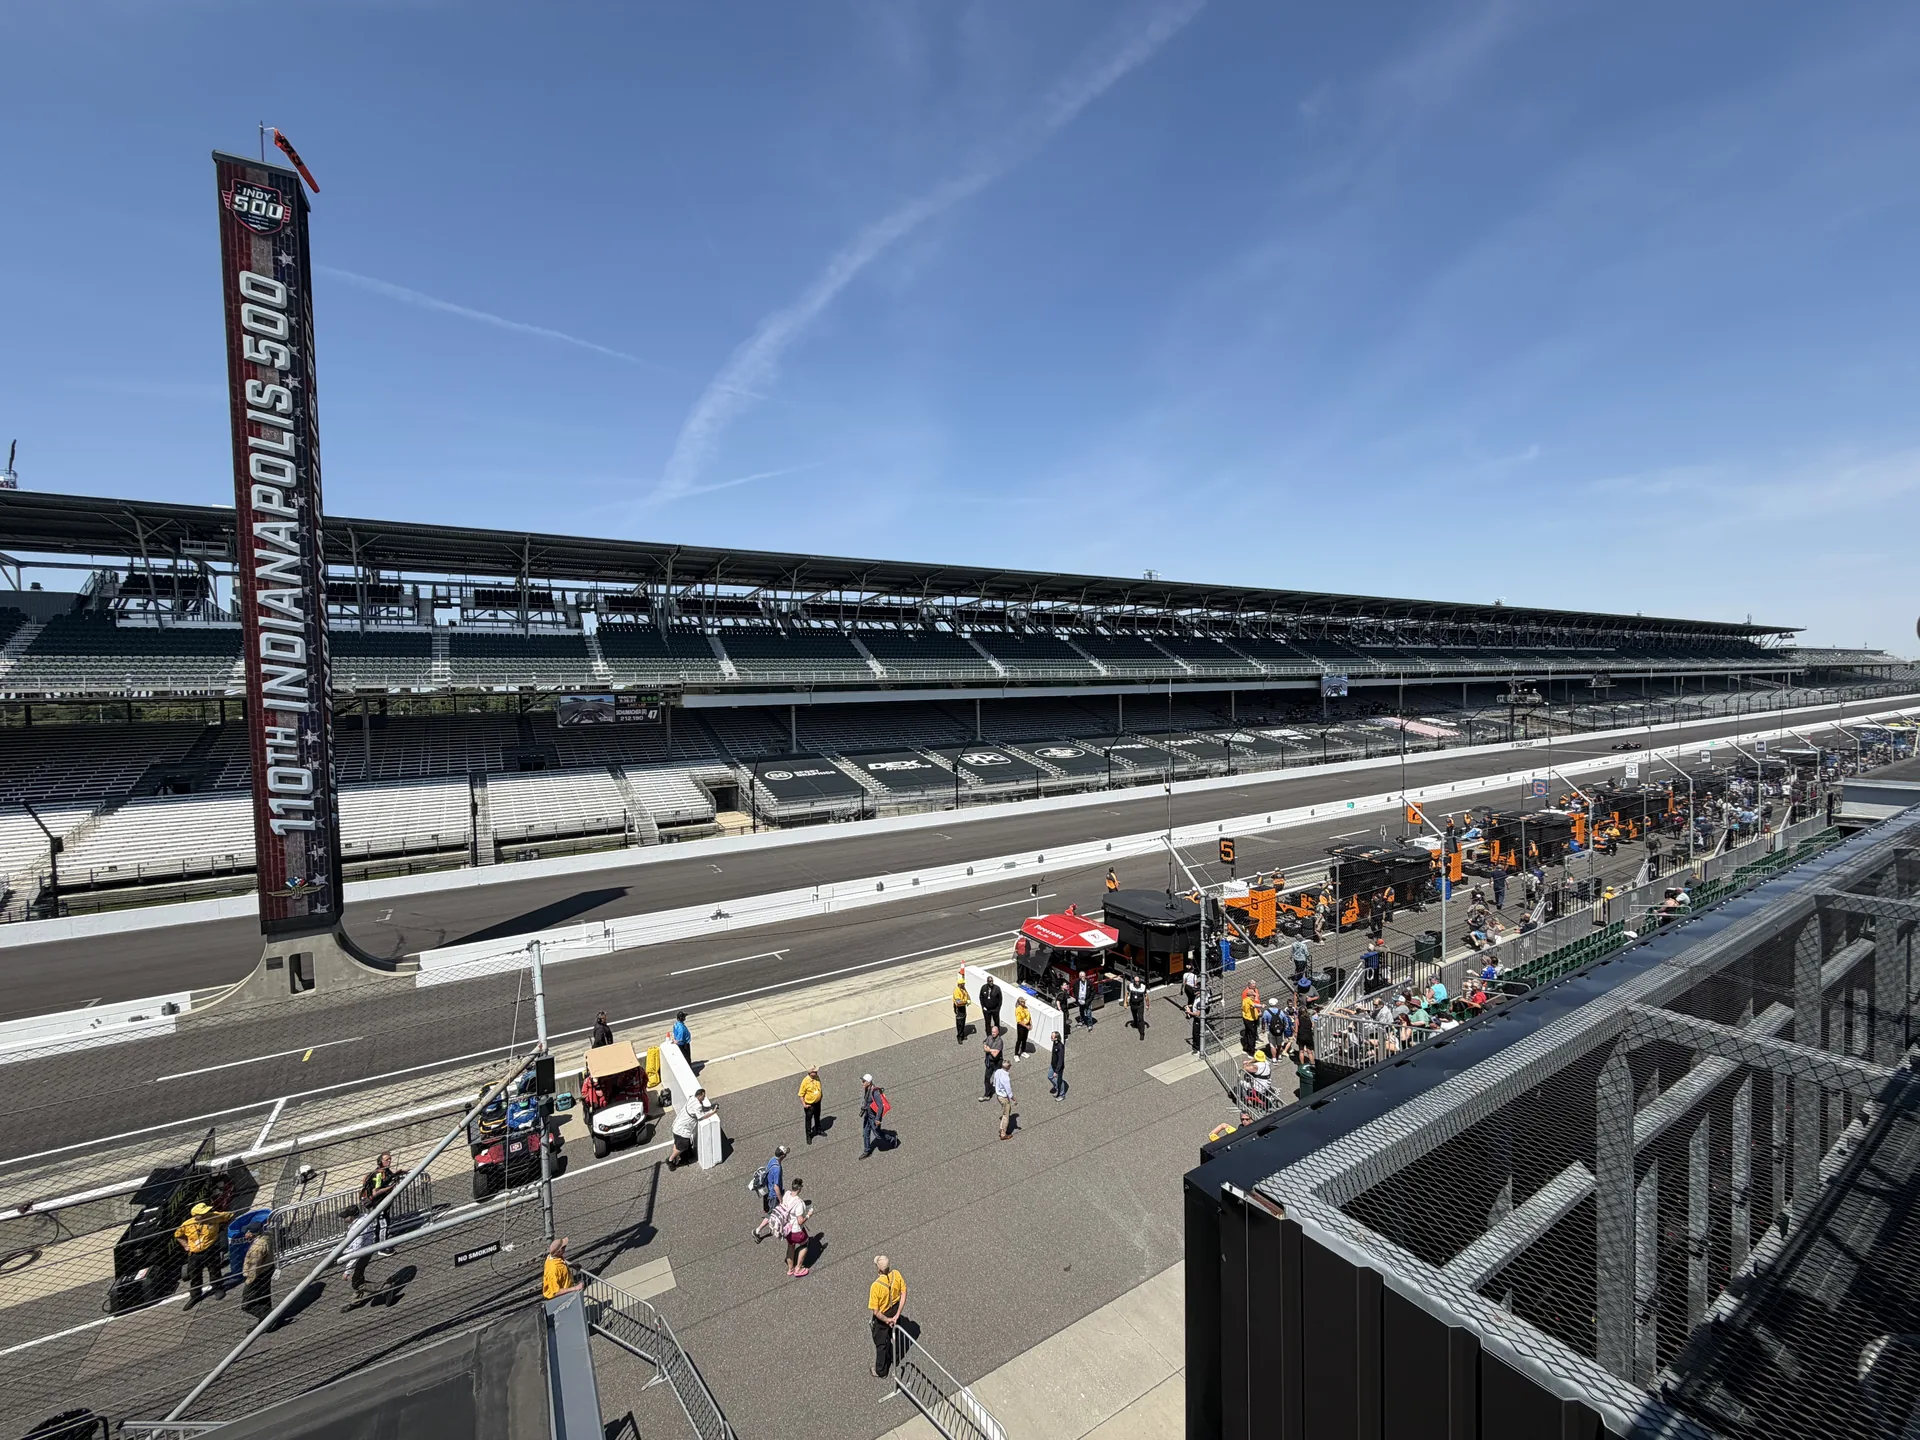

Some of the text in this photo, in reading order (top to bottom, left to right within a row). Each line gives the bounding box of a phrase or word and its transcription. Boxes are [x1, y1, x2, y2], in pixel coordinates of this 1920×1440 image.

[242, 187, 272, 200] INDY
[232, 194, 284, 220] 500
[239, 270, 291, 371] 500
[245, 379, 310, 713] INDIANAPOLIS
[648, 710, 658, 719] 47
[1627, 766, 1637, 774] 31
[265, 726, 316, 836] 110TH
[1533, 781, 1546, 796] 6
[1221, 840, 1234, 861] 5
[1033, 924, 1064, 940] Firestone
[457, 1245, 497, 1263] NO SMOKING
